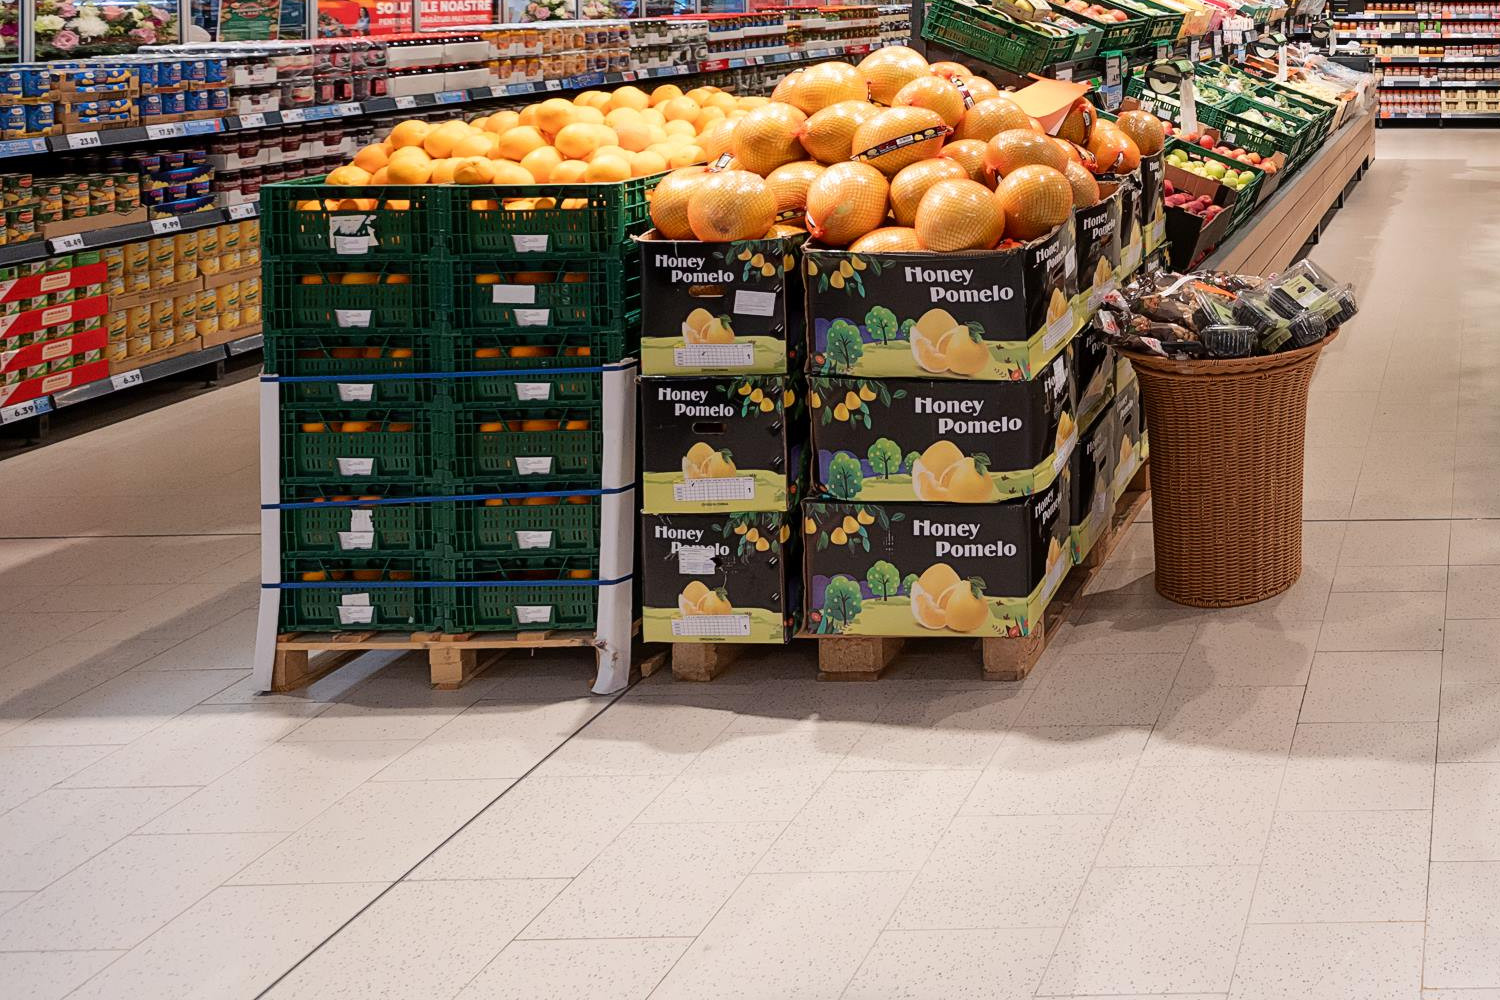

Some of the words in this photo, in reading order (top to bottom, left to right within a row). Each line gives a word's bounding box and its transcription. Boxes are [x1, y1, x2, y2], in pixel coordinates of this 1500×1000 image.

[440, 0, 492, 12] NOASTRE
[163, 220, 178, 230] 9.99
[1084, 212, 1108, 231] Honey
[1092, 219, 1116, 239] Pomelo
[1036, 241, 1060, 264] Honey
[655, 254, 705, 270] Honey
[671, 270, 734, 283] Pomelo
[904, 266, 974, 285] Honey
[930, 285, 1014, 303] Pomelo
[124, 374, 140, 384] 6.39
[658, 388, 709, 403] Honey
[15, 406, 34, 417] 6.39
[674, 403, 734, 416] Pomelo
[915, 397, 984, 416] Honey
[938, 416, 1022, 434] Pomelo
[1035, 488, 1054, 518] Honey
[655, 525, 704, 542] Honey
[913, 520, 981, 540] Honey
[935, 541, 1017, 557] Pomelo
